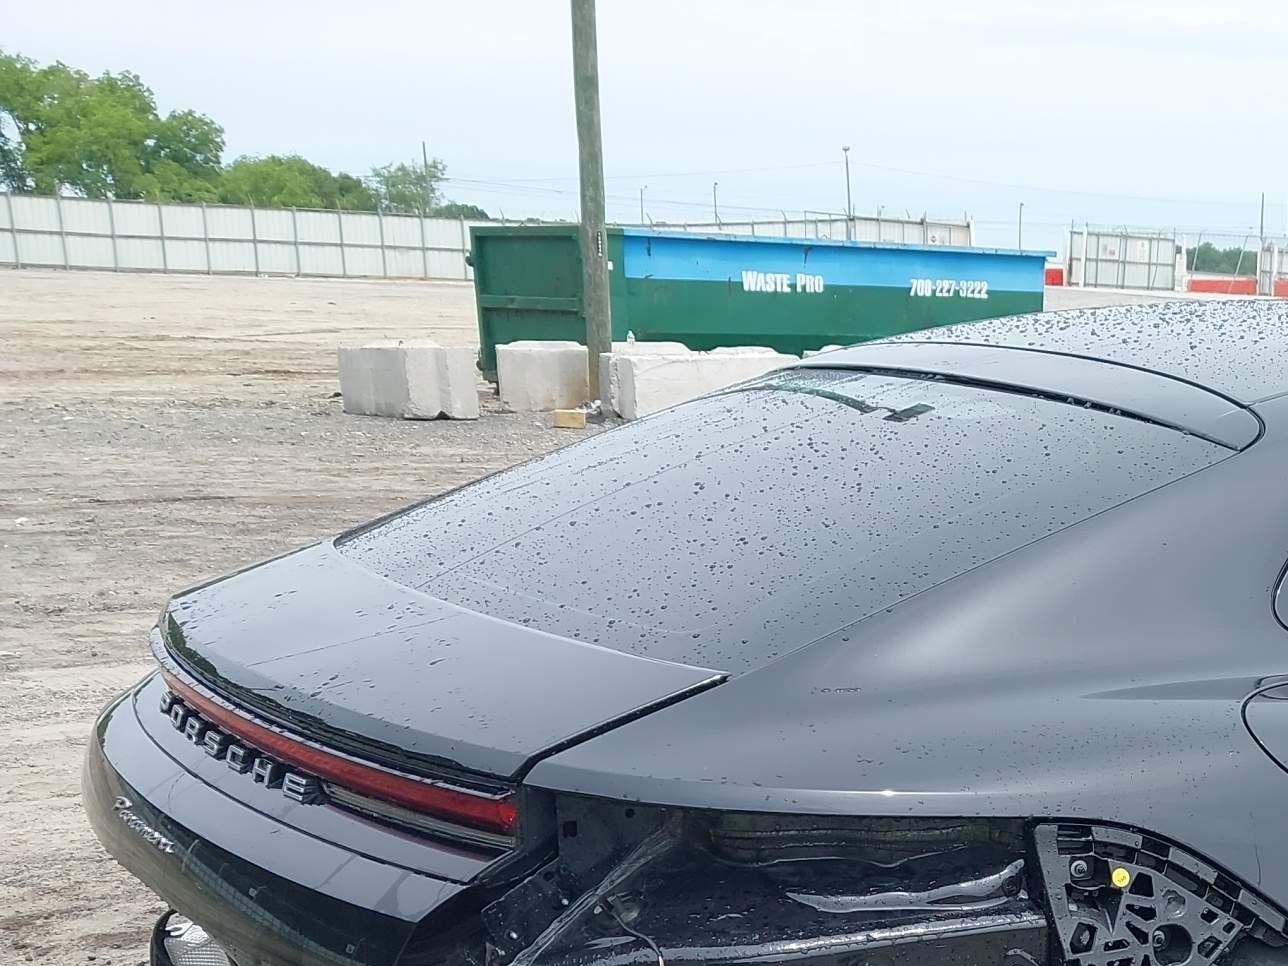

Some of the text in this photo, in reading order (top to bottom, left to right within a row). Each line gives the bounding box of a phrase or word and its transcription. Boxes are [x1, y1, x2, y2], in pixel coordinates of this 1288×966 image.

[741, 270, 825, 293] WASTE PRO
[160, 690, 310, 804] PORSCHE
